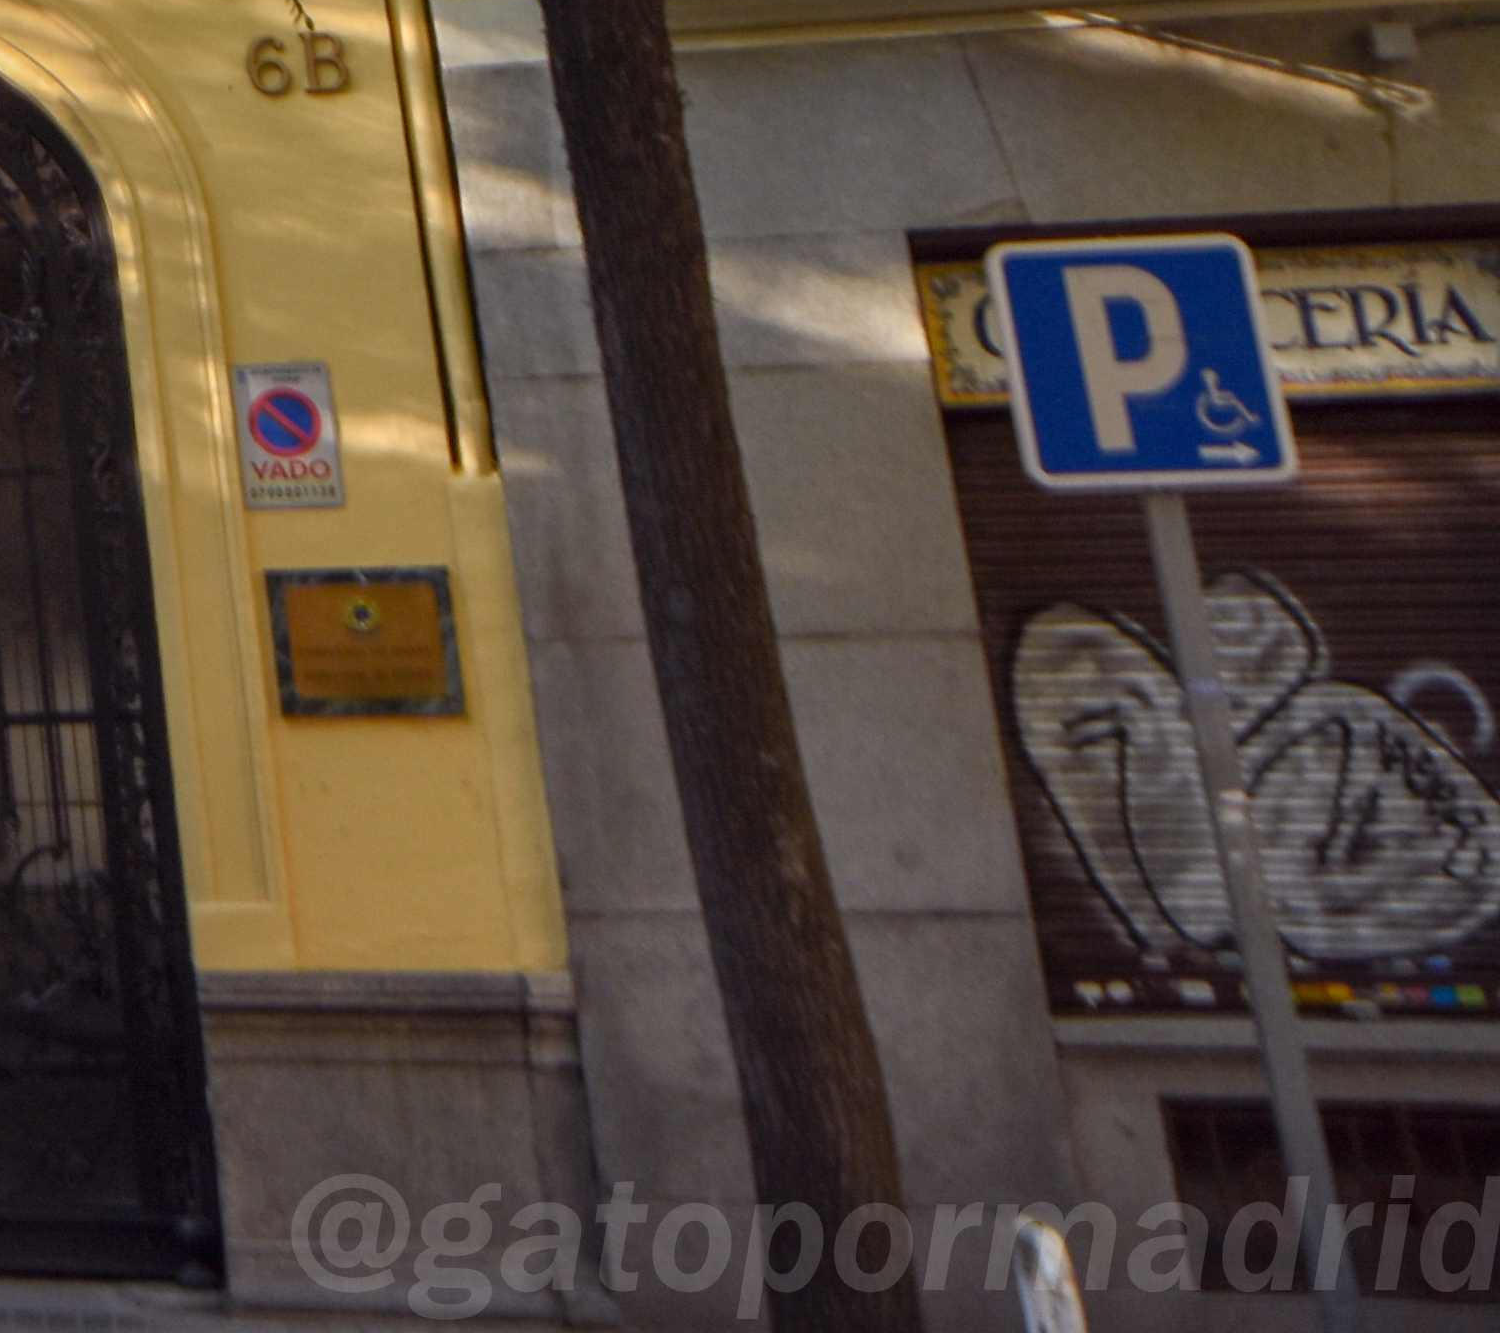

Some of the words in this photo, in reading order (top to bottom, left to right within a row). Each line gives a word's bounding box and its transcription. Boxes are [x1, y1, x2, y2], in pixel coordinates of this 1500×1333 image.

[246, 31, 351, 97] 6B
[1062, 264, 1190, 454] P
[251, 458, 332, 480] VADO
